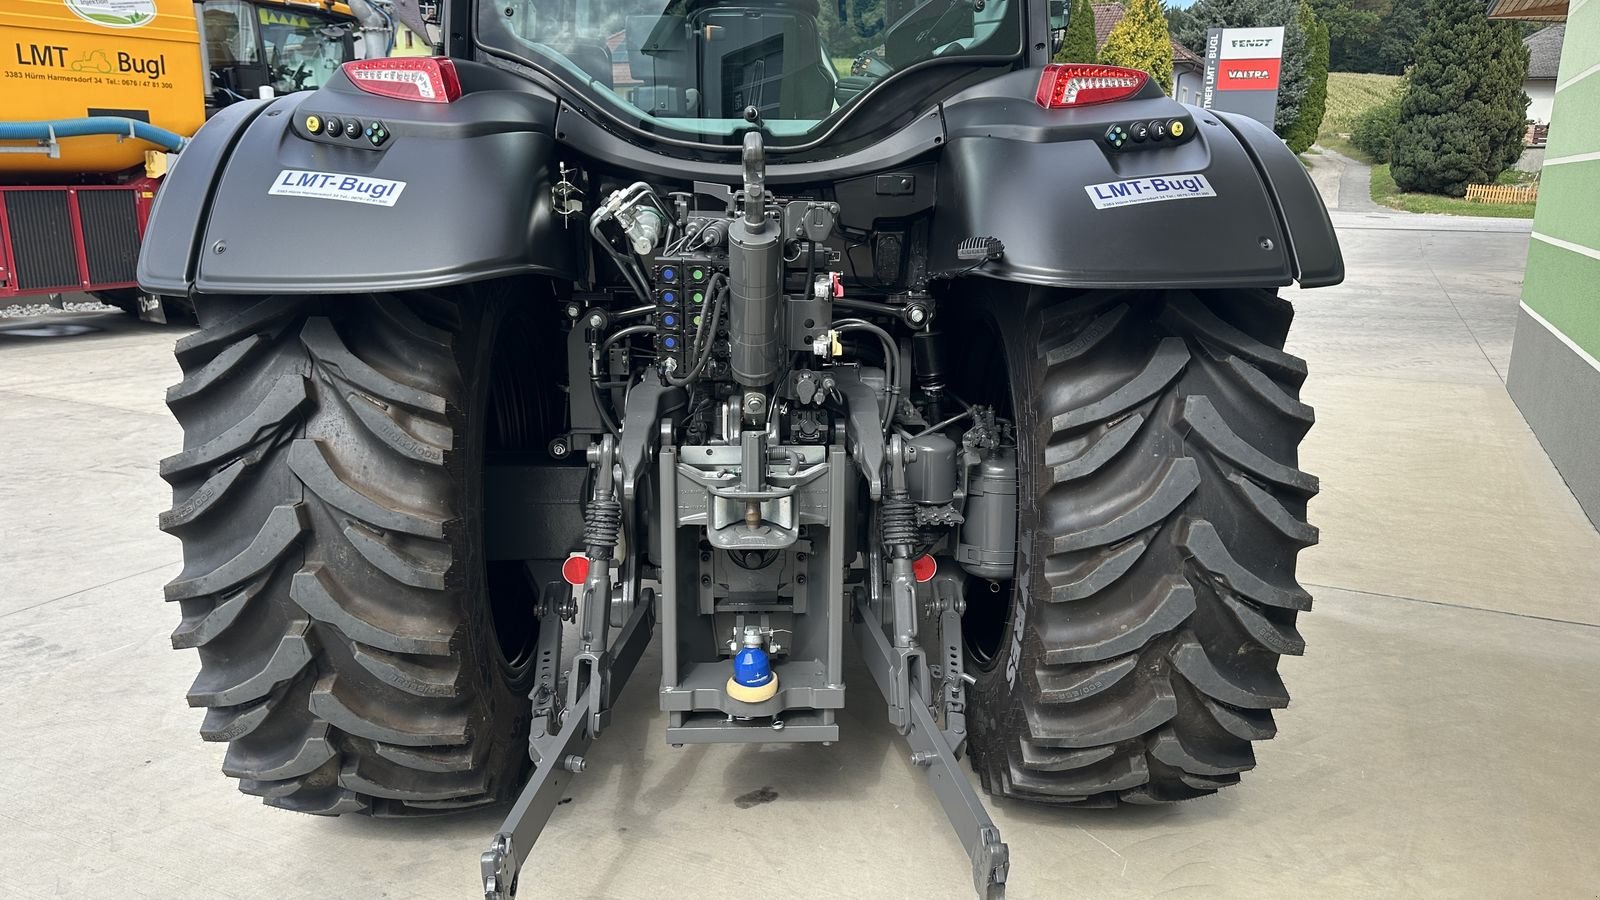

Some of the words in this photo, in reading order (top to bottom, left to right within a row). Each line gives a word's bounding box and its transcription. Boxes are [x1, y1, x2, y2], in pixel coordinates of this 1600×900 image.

[1209, 33, 1218, 58] BUGL
[1231, 39, 1272, 47] FENDT
[15, 43, 69, 68] LMT
[117, 51, 166, 80] Bugl
[24, 71, 46, 80] Hürm
[47, 74, 92, 83] Harmersdorf
[1206, 65, 1215, 85] LMT
[1228, 70, 1270, 79] VALTRA
[281, 172, 397, 199] LMT-Bugl
[1093, 175, 1204, 200] LMT-Bugl
